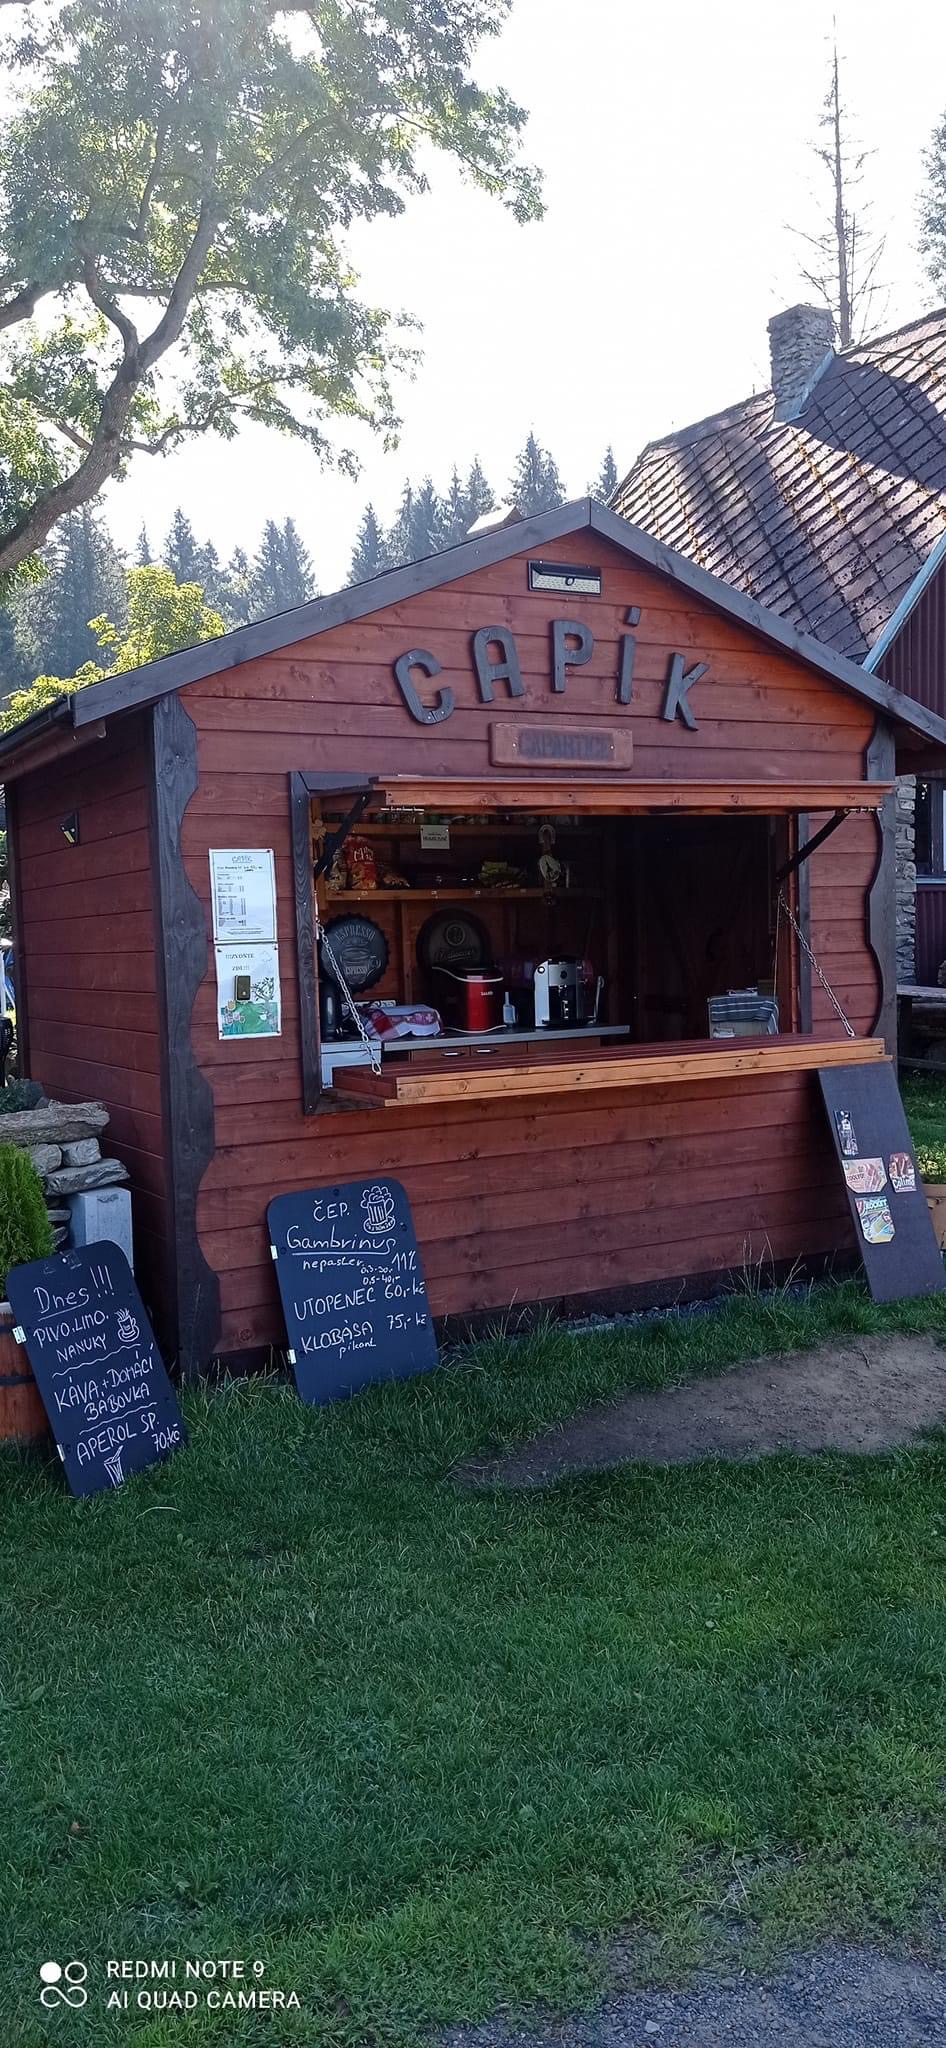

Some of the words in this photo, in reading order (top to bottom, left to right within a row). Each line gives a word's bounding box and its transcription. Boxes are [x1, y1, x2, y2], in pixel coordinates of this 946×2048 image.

[313, 1200, 350, 1222] ČEP.
[286, 1224, 396, 1254] Gambrinus
[391, 1250, 416, 1271] 11%
[33, 1286, 90, 1314] Dnes
[294, 1287, 376, 1321] UTOPENEC
[56, 1333, 107, 1363] NANUKY
[300, 1319, 373, 1354] KLOBÁSA
[54, 1376, 99, 1413] KÁVA
[84, 1382, 150, 1421] BÁBOVKA
[77, 1421, 137, 1466] APEROL
